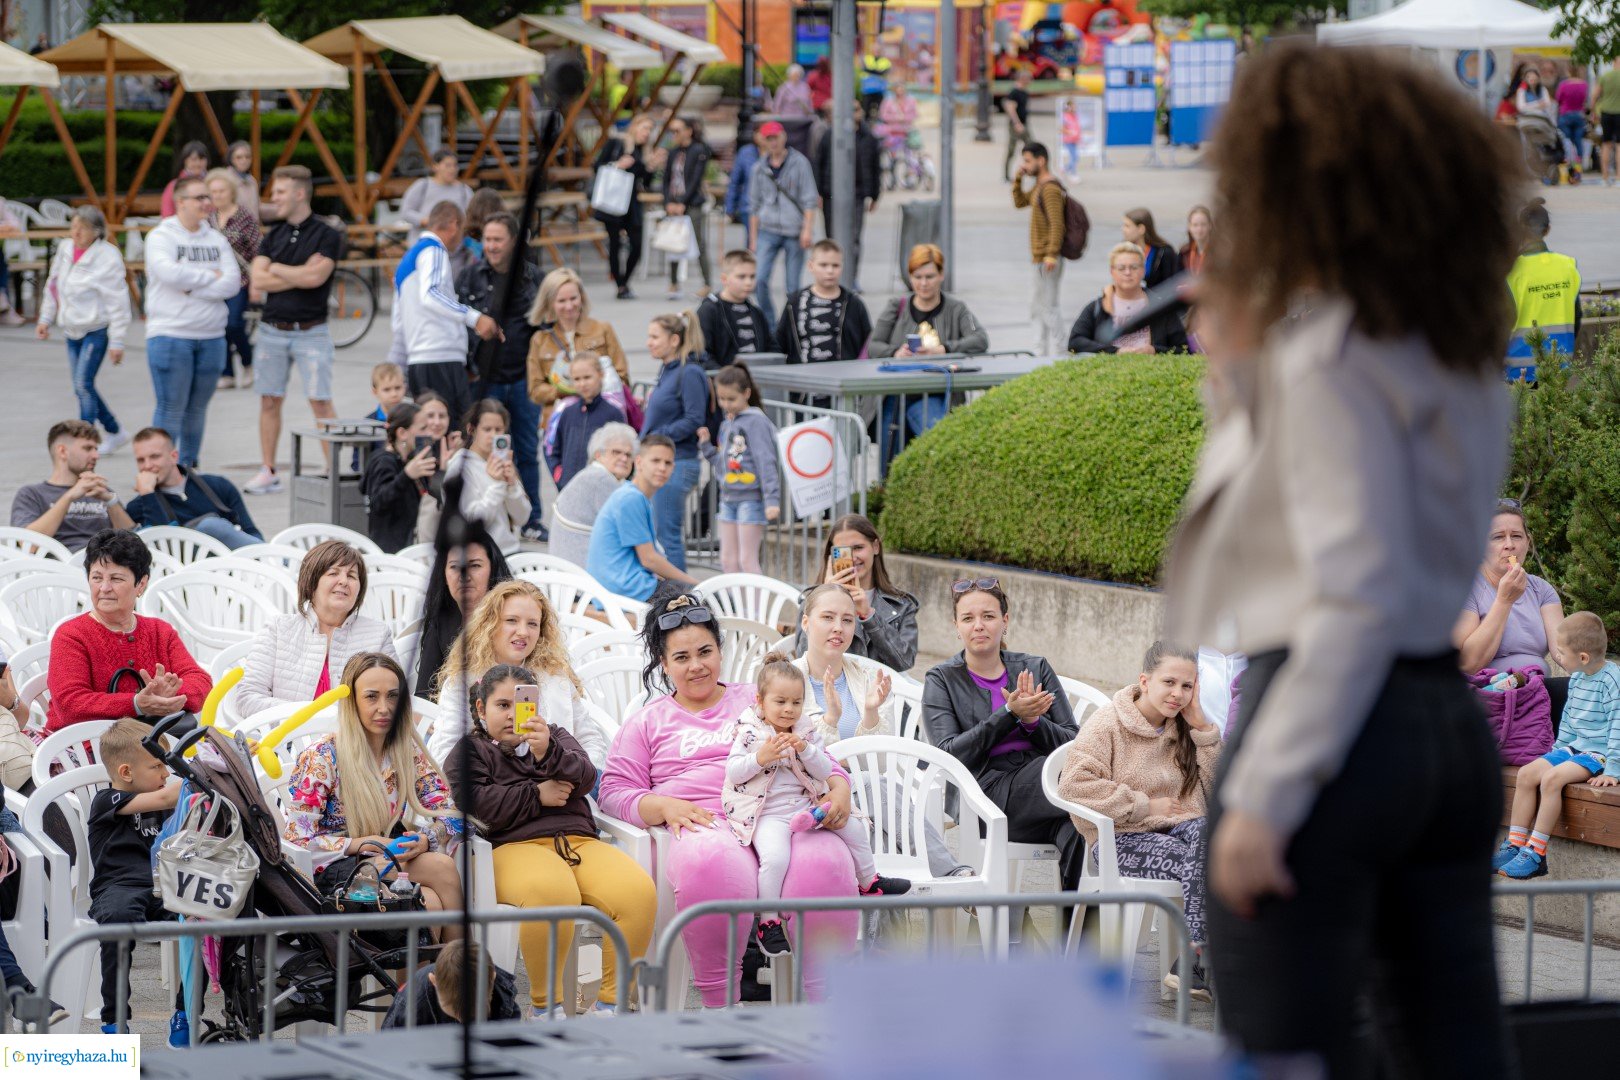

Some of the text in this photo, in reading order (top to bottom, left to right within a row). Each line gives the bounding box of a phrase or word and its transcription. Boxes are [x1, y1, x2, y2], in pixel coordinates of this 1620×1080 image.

[678, 721, 736, 758] Barb
[1142, 854, 1183, 875] ROCK
[176, 870, 234, 910] YES
